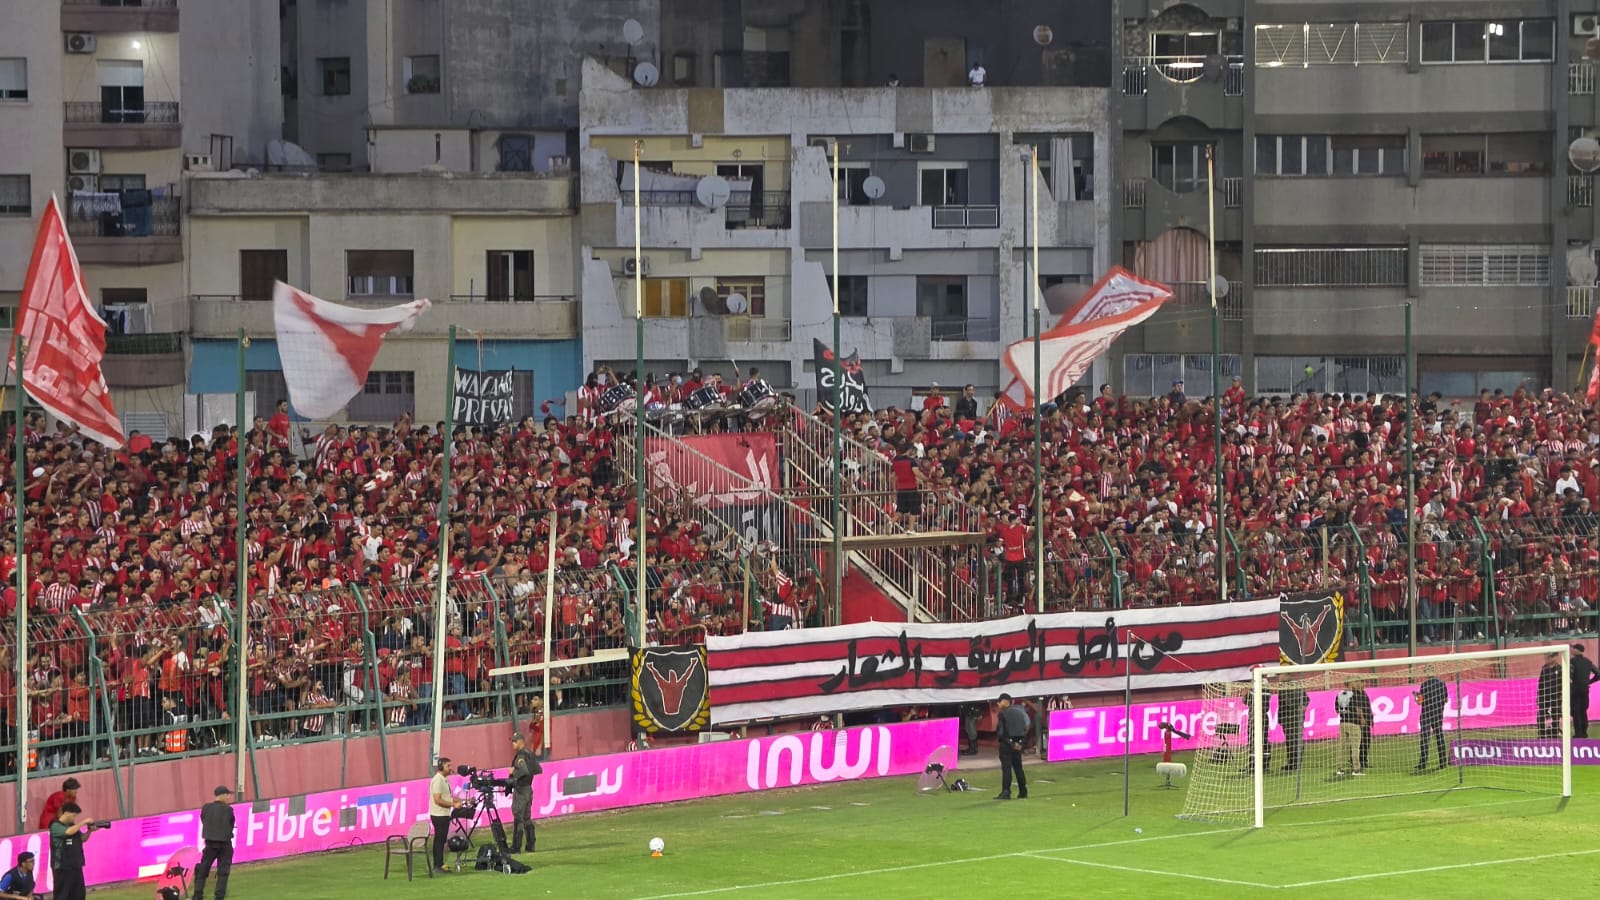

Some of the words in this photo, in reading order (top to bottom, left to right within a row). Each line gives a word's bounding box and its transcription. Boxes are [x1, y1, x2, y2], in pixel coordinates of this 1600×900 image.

[1098, 711, 1134, 745] La
[1142, 704, 1218, 741] Fibre
[246, 801, 332, 847] Fibre
